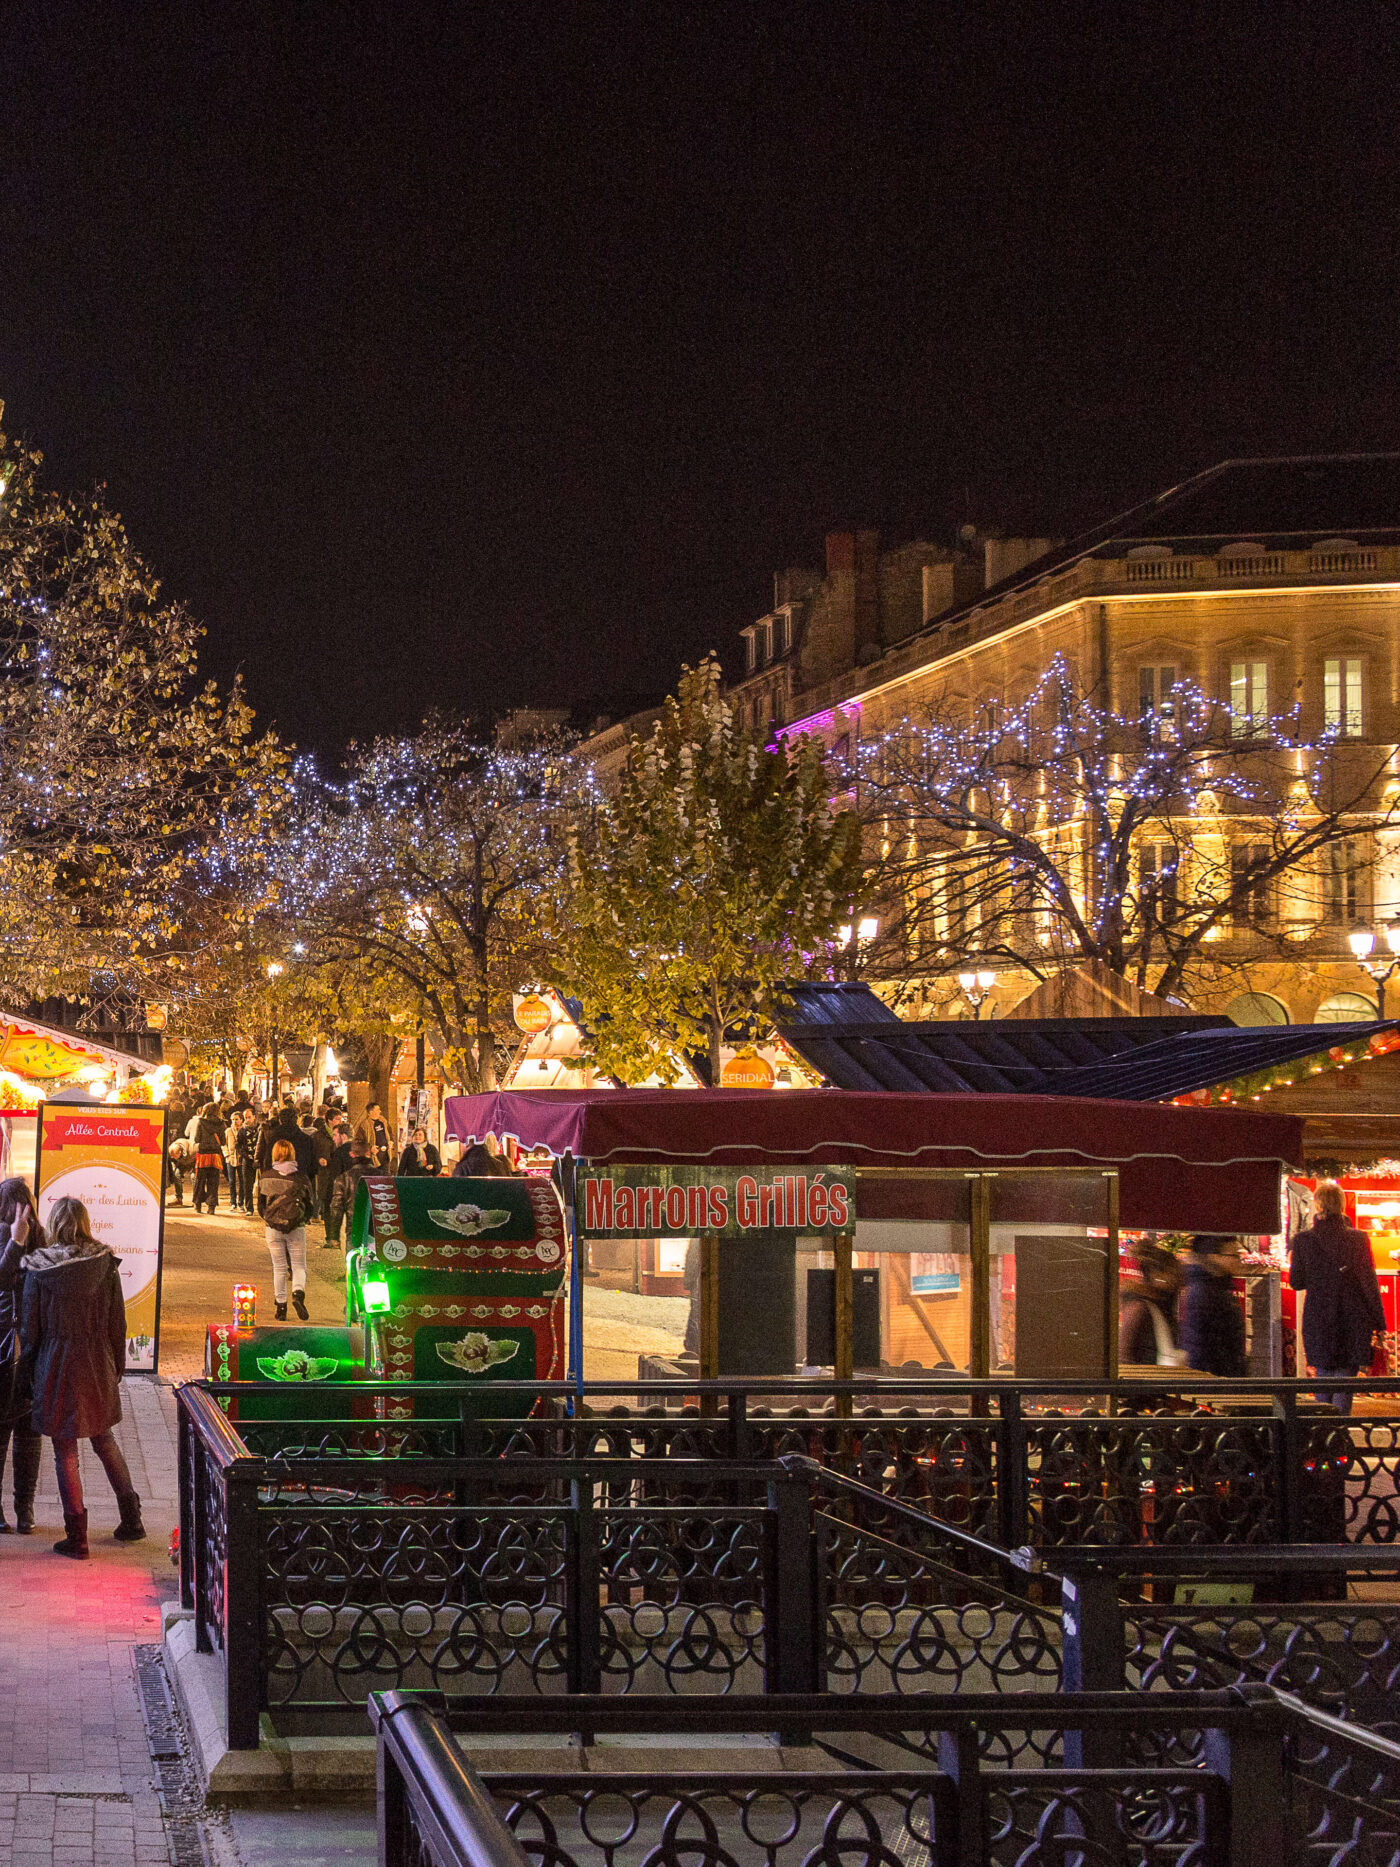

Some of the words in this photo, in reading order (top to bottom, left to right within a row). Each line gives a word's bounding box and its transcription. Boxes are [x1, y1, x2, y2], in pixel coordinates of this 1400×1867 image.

[721, 1073, 775, 1084] SERIDIAL
[65, 1123, 94, 1137] Allée
[97, 1125, 139, 1137] Centrale
[98, 1194, 114, 1205] des
[116, 1194, 147, 1206] Lutins
[585, 1178, 728, 1230] Marrons
[736, 1174, 849, 1229] Grillés
